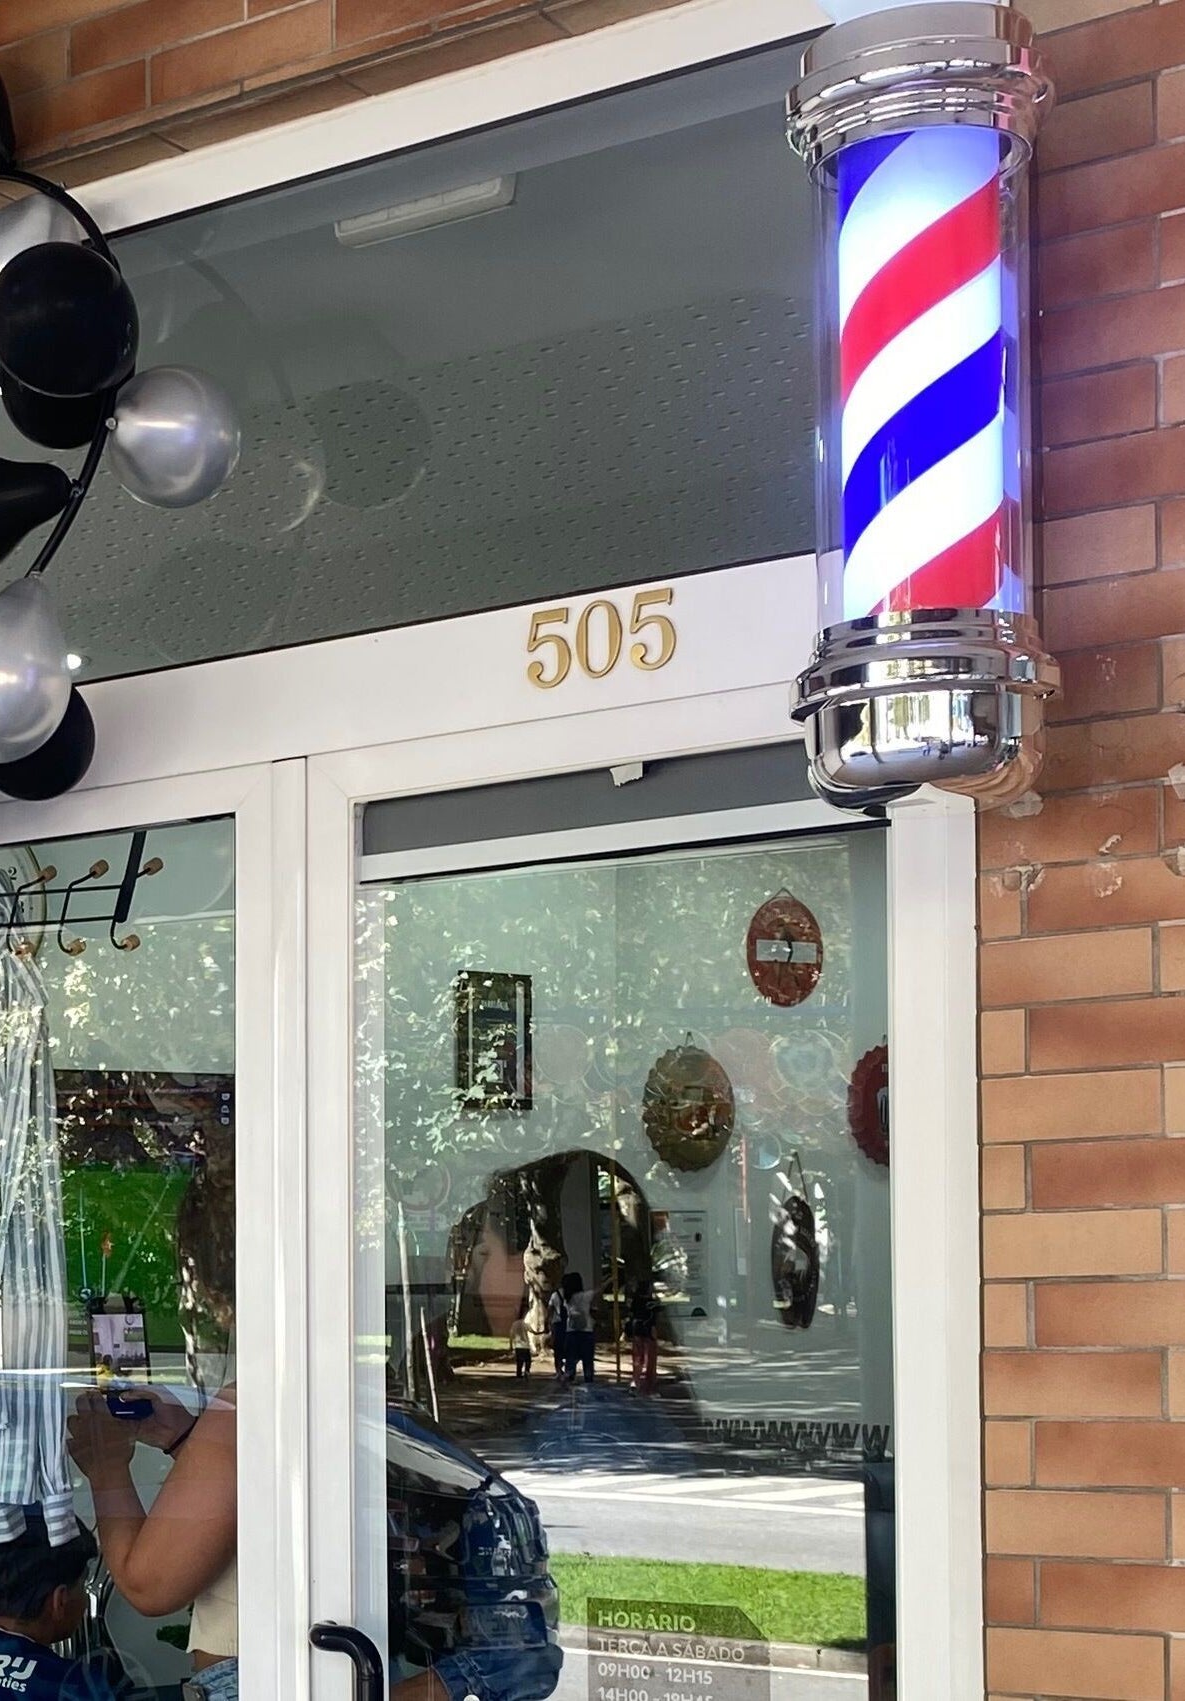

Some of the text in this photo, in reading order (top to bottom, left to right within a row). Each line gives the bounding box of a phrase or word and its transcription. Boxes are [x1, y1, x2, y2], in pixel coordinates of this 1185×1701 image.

[527, 587, 677, 689] 505
[8, 866, 17, 881] 2
[598, 1609, 696, 1632] HORÁRIO
[656, 1642, 669, 1656] A
[672, 1639, 745, 1662] SÁBADO
[598, 1662, 651, 1680] 09H00
[665, 1667, 713, 1685] 12H15
[597, 1686, 649, 1701] 14H00
